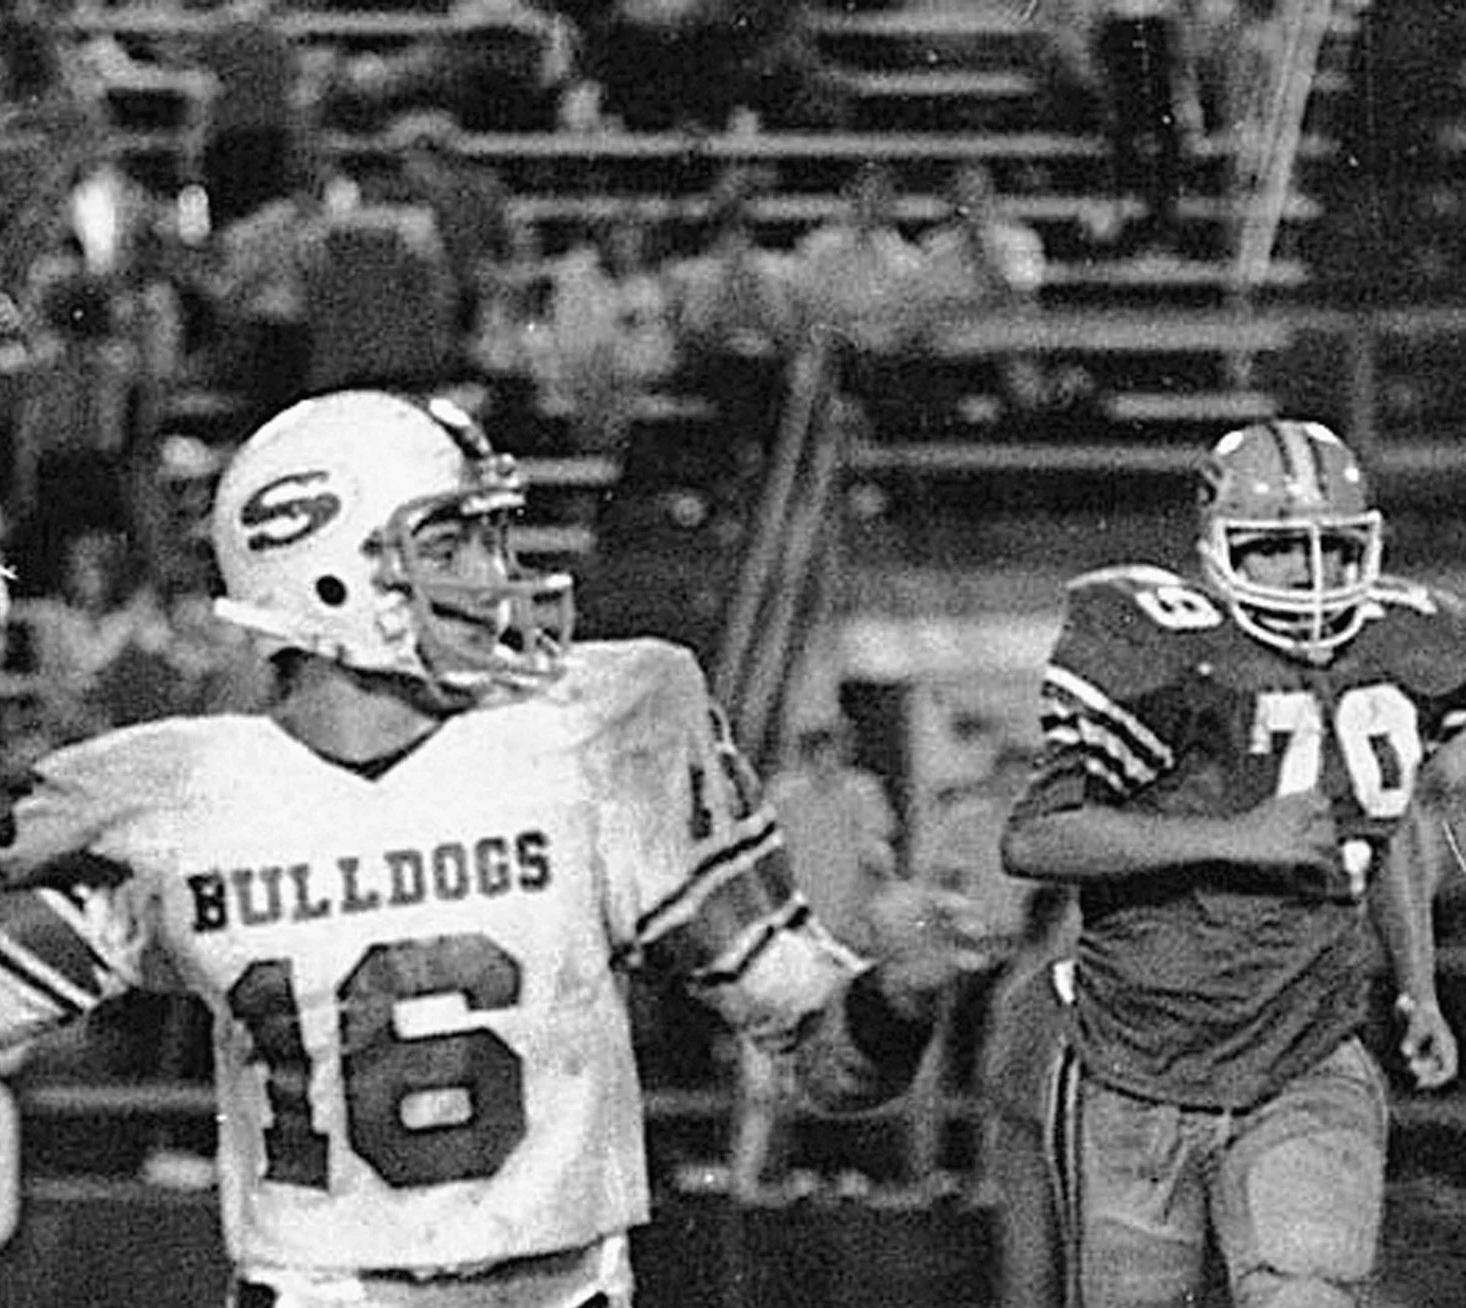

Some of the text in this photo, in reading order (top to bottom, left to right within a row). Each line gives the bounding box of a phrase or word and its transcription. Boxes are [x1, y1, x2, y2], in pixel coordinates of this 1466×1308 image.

[240, 468, 343, 553] S
[186, 830, 551, 934] BULLDOGS
[226, 930, 528, 1189] 16
